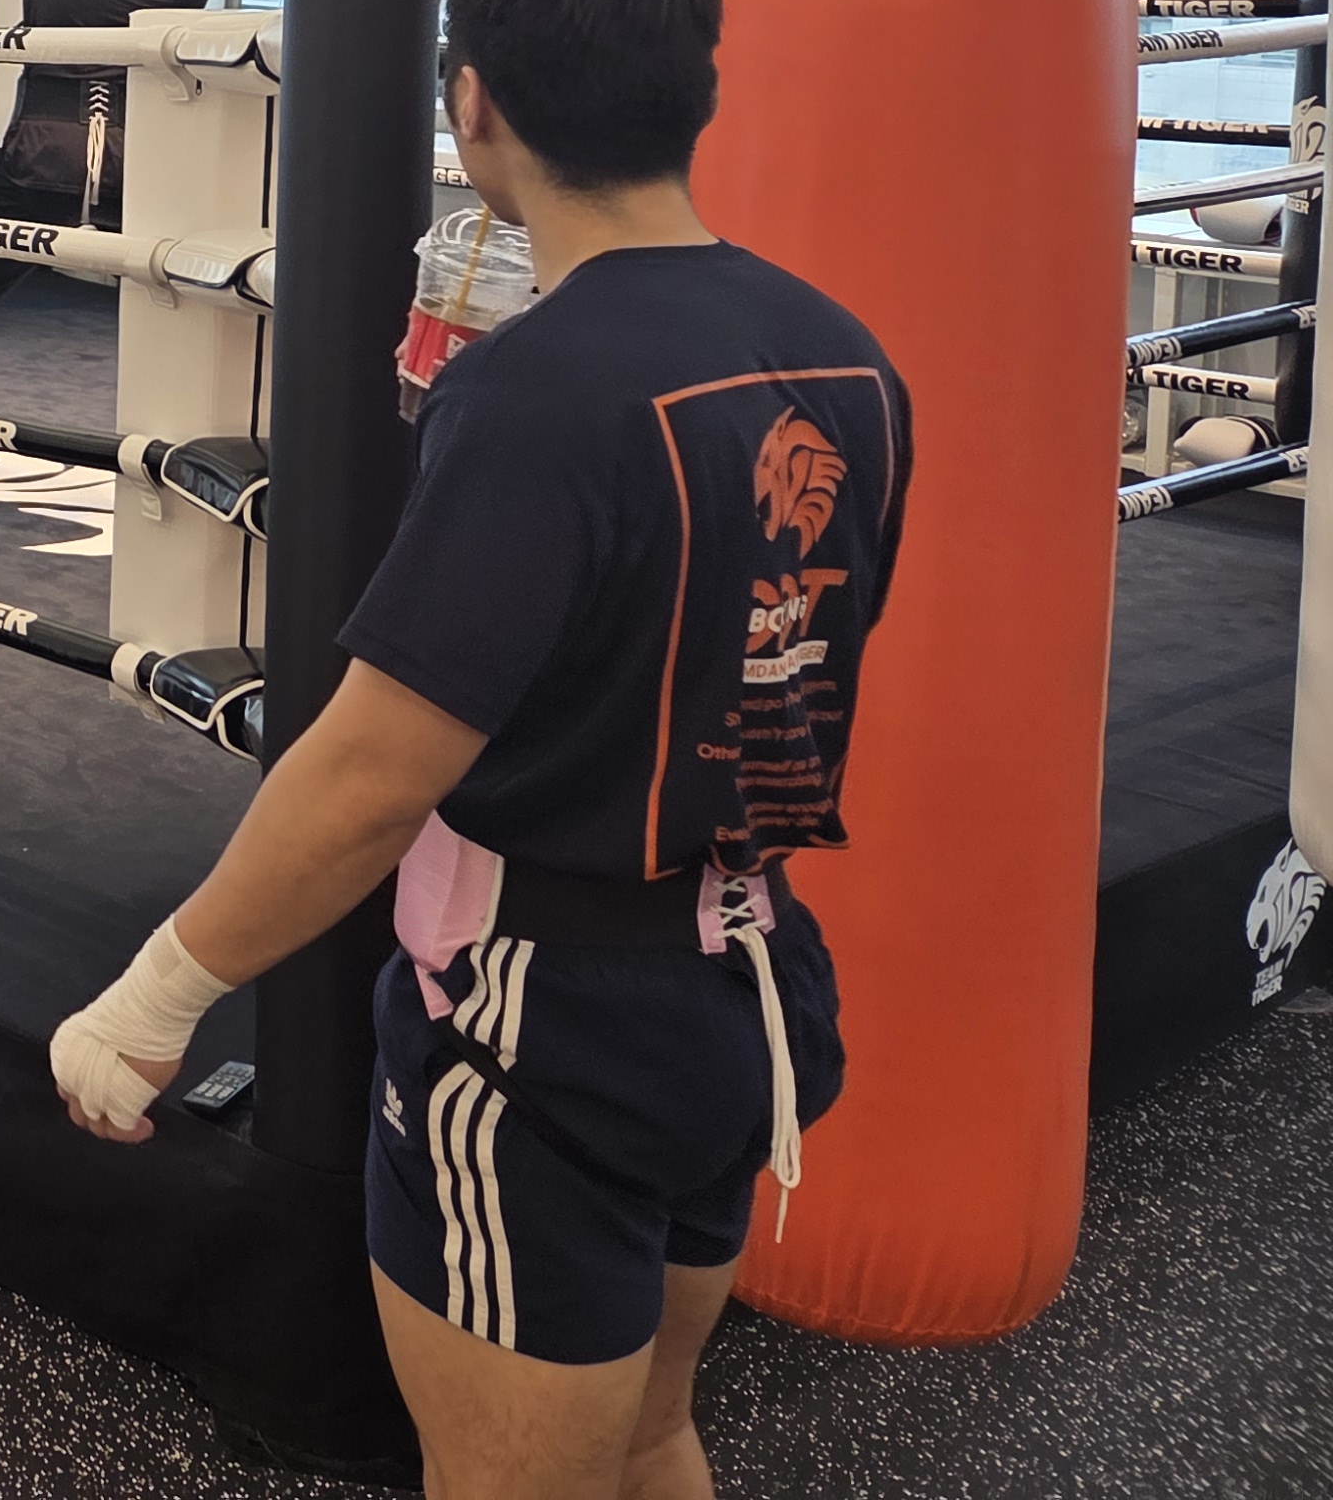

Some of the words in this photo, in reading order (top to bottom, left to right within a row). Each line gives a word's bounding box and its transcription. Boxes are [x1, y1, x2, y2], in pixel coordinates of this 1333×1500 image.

[1153, 0, 1256, 18] TIGER
[1169, 28, 1224, 50] TIGER
[1146, 246, 1244, 274] TIGER
[1152, 370, 1252, 401] TIGER
[1255, 958, 1285, 989] TEAM
[1251, 974, 1284, 1007] TIGER
